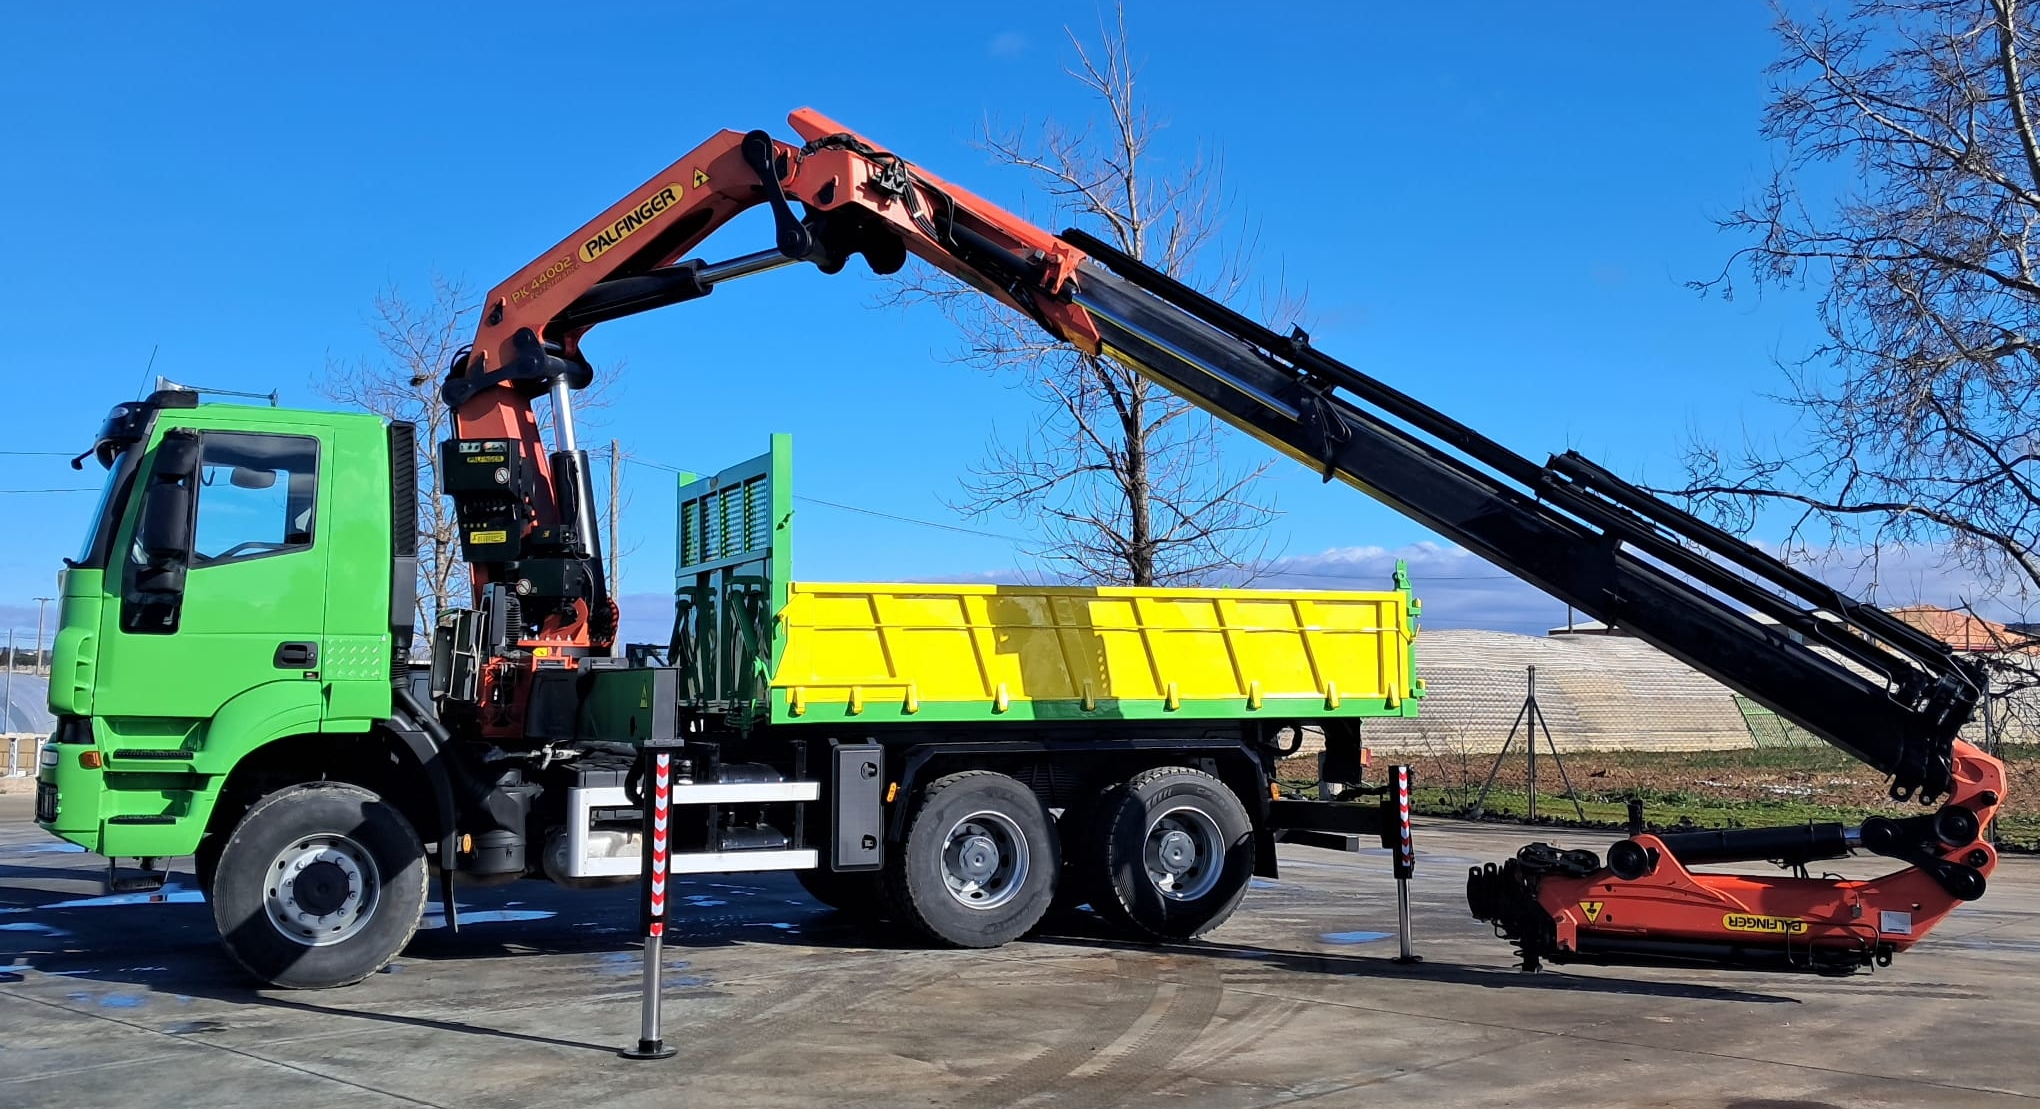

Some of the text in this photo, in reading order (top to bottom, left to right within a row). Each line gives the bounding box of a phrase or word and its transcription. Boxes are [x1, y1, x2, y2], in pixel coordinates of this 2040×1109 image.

[585, 187, 676, 258] PALFINGER
[511, 256, 573, 304] PK 44002
